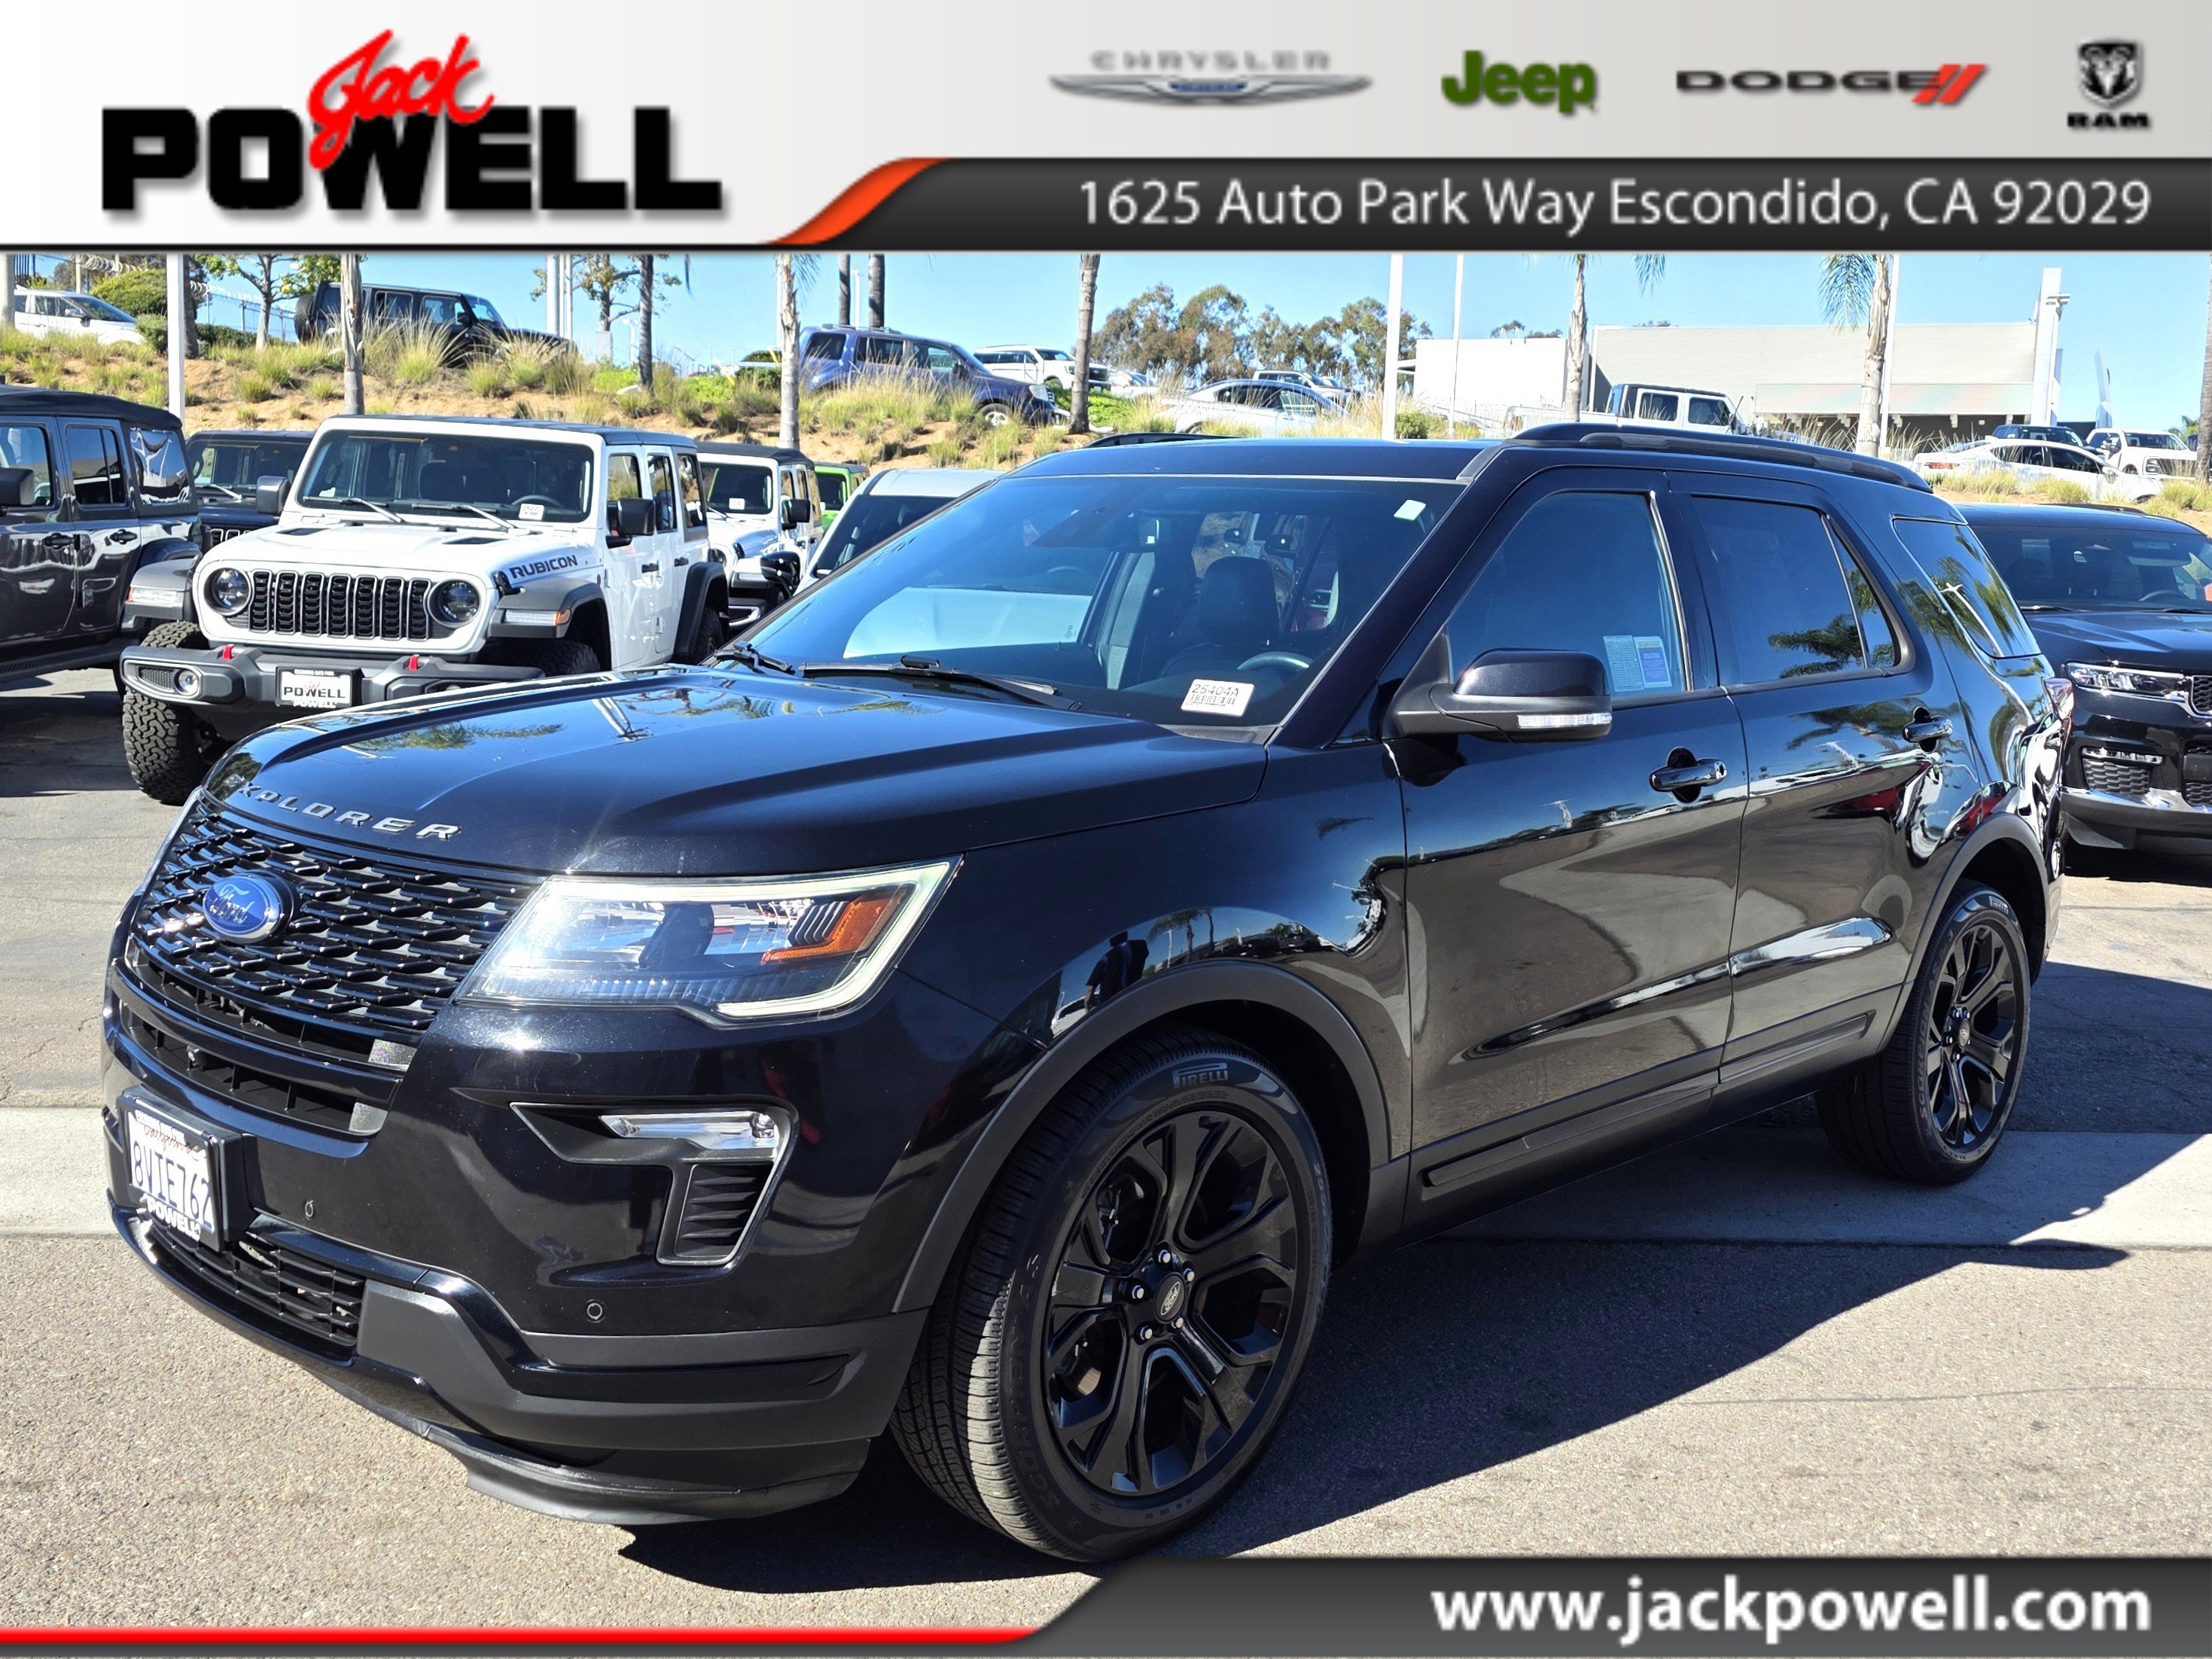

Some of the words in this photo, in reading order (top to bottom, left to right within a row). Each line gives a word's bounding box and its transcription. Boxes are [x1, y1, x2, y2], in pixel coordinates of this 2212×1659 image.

[508, 555, 578, 579] RUBICON
[283, 686, 346, 699] POWELL
[1192, 683, 1239, 698] 25404A
[238, 781, 461, 841] XPLORER
[209, 882, 256, 925] Ford
[1172, 1062, 1228, 1088] PIRELLI
